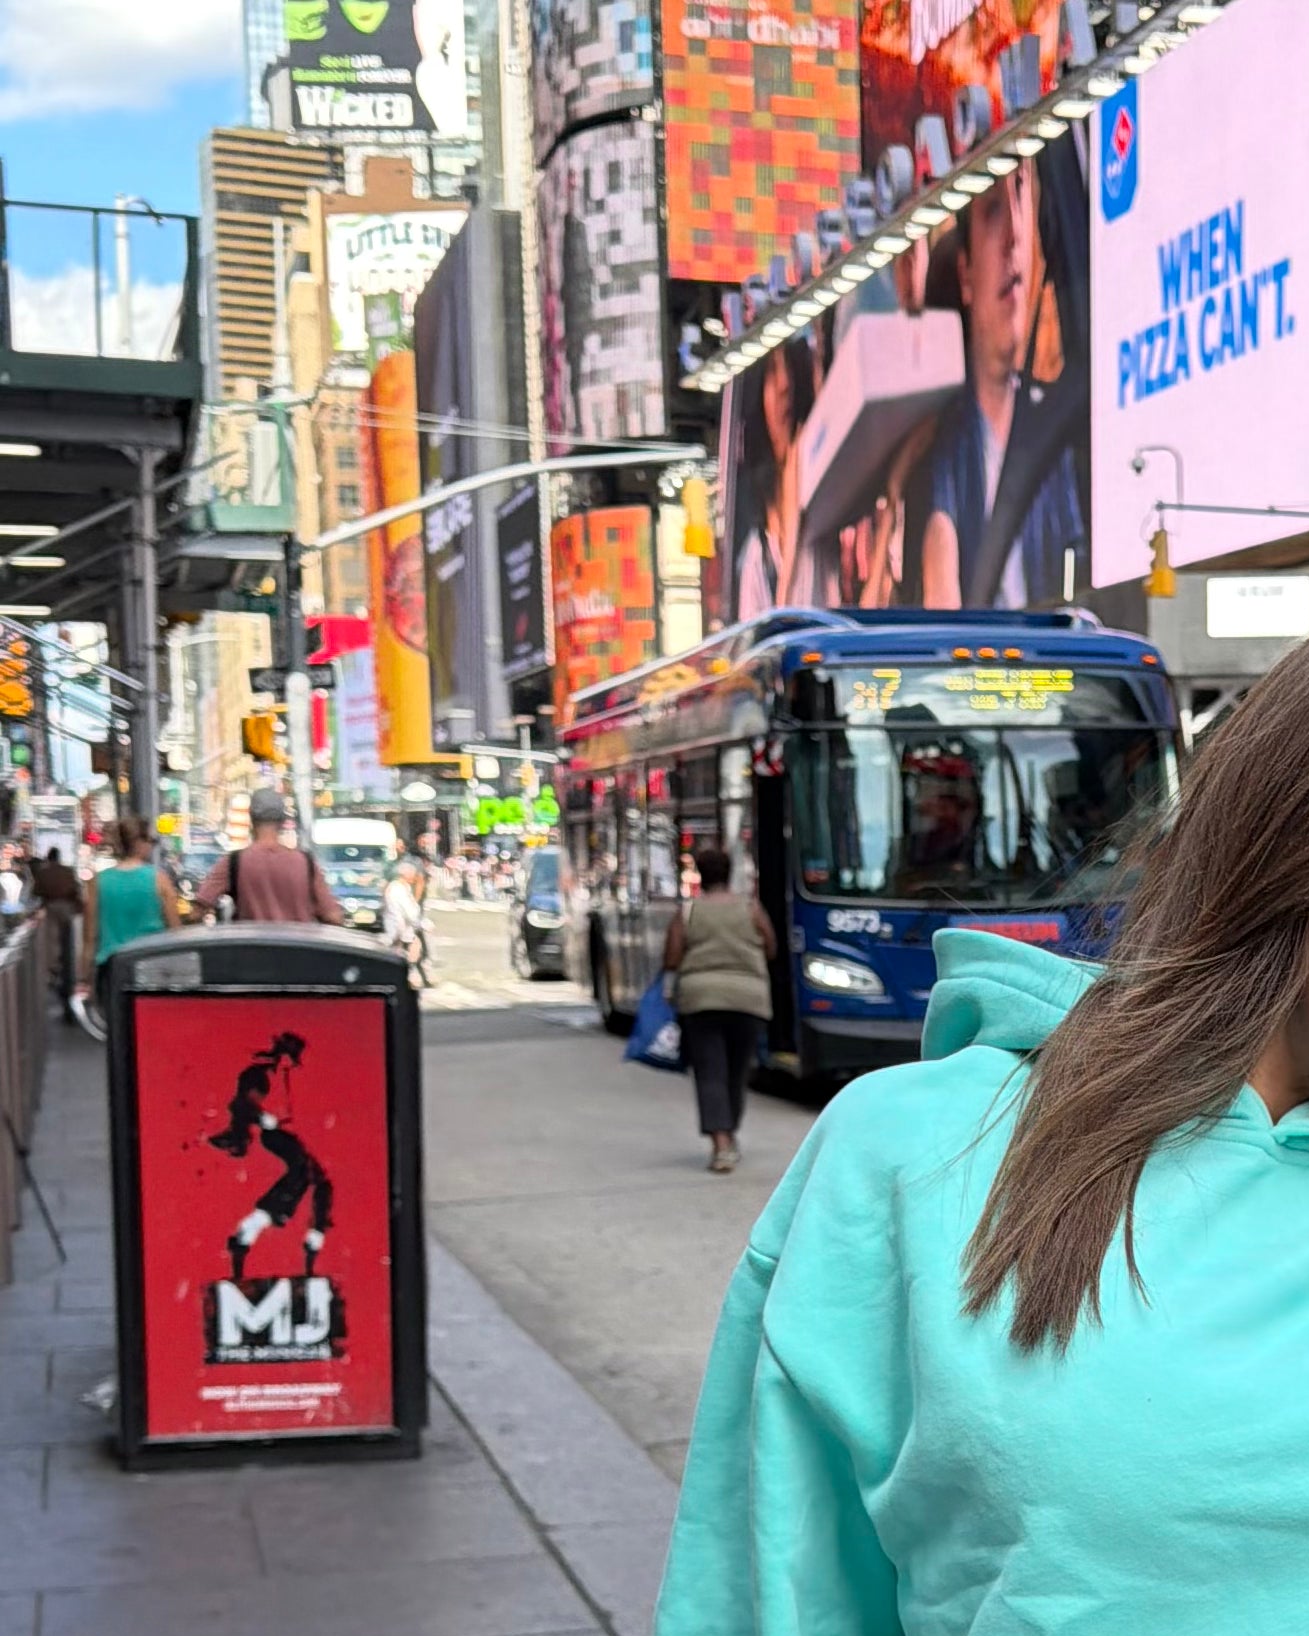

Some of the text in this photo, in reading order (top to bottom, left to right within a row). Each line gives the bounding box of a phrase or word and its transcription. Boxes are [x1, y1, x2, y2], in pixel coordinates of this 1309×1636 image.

[346, 221, 413, 260] LITTLE
[1157, 196, 1245, 314] WHEN
[1117, 257, 1296, 410] PIZZA CAN'T.
[217, 1276, 334, 1346] MJ
